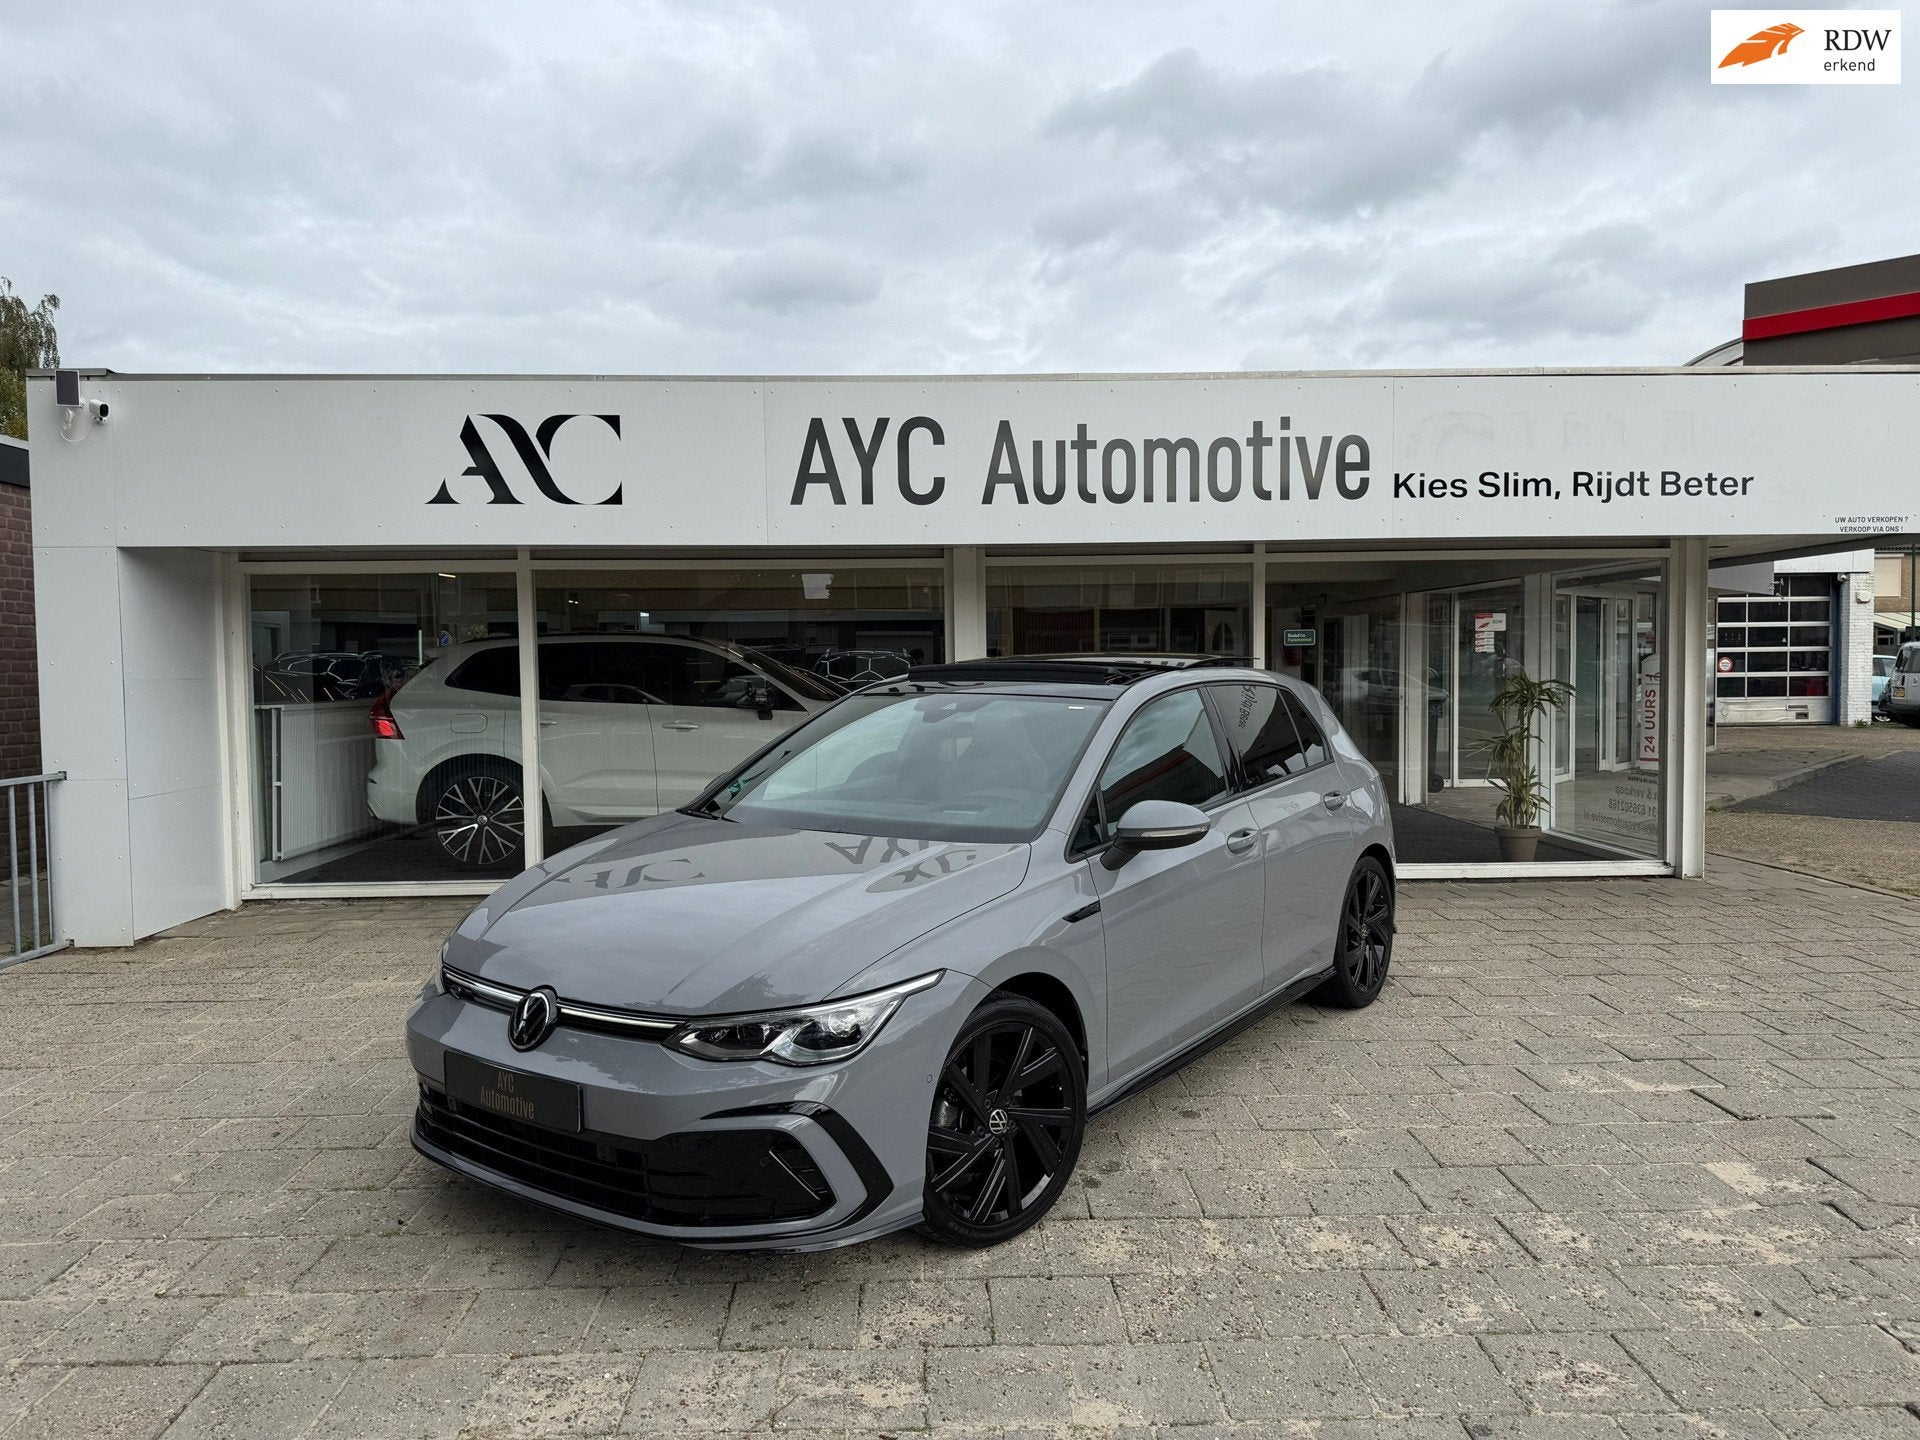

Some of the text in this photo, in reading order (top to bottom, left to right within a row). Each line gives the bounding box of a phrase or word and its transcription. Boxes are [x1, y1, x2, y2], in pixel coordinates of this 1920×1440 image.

[790, 415, 946, 506] AYC
[981, 416, 1371, 506] Automotive
[1393, 470, 1755, 504] Kies Slim, Rijdt Beter
[1834, 516, 1847, 524] UW
[1644, 689, 1656, 753] 24 UURS
[497, 1070, 515, 1094] AYC
[480, 1086, 534, 1120] Automotive
